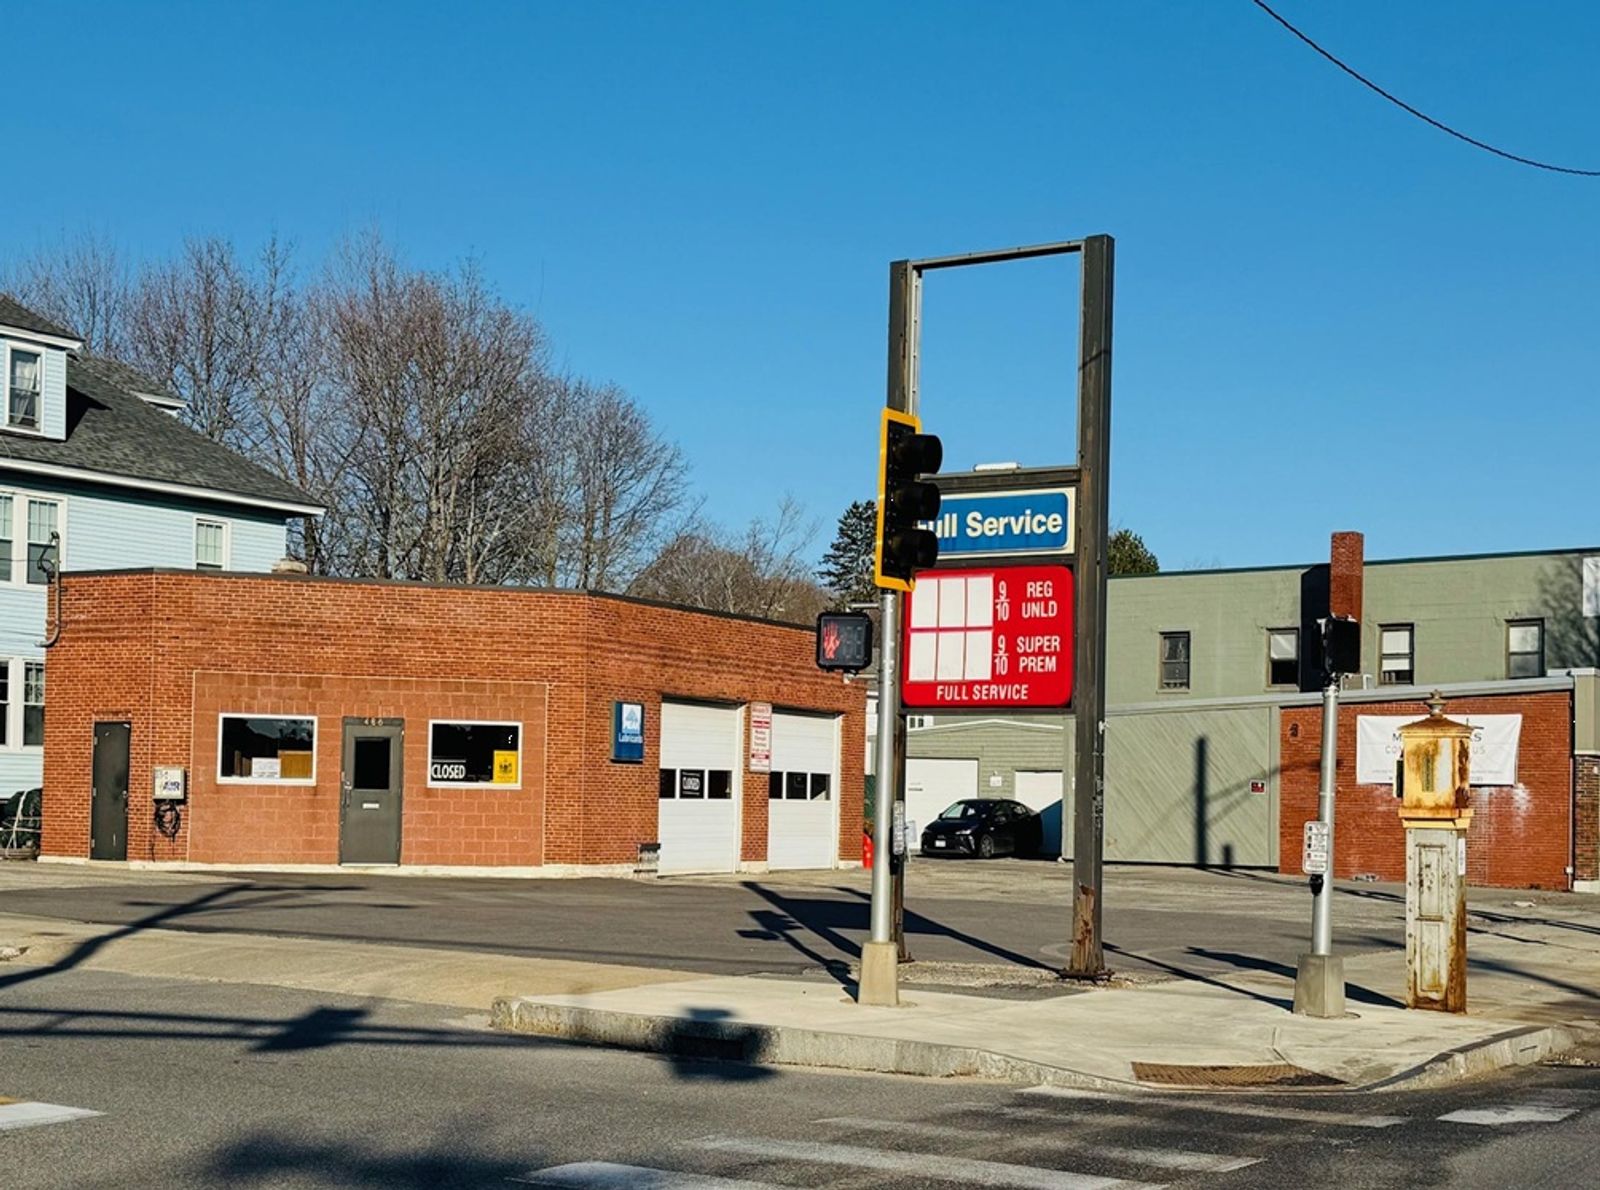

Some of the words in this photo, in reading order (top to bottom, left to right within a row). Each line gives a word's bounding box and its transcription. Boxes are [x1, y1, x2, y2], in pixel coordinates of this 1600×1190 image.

[916, 512, 958, 539] ull
[965, 508, 1063, 538] Service
[998, 580, 1007, 600] 9
[1026, 581, 1054, 599] REG
[995, 602, 1010, 622] 10
[1021, 600, 1058, 619] UNLD
[997, 634, 1006, 654] 9
[1016, 635, 1061, 654] SUPER
[994, 655, 1009, 676] 10
[1019, 655, 1057, 673] PREM
[936, 685, 969, 701] FULL
[971, 683, 1030, 700] SERVICE
[431, 764, 467, 779] CLOSED
